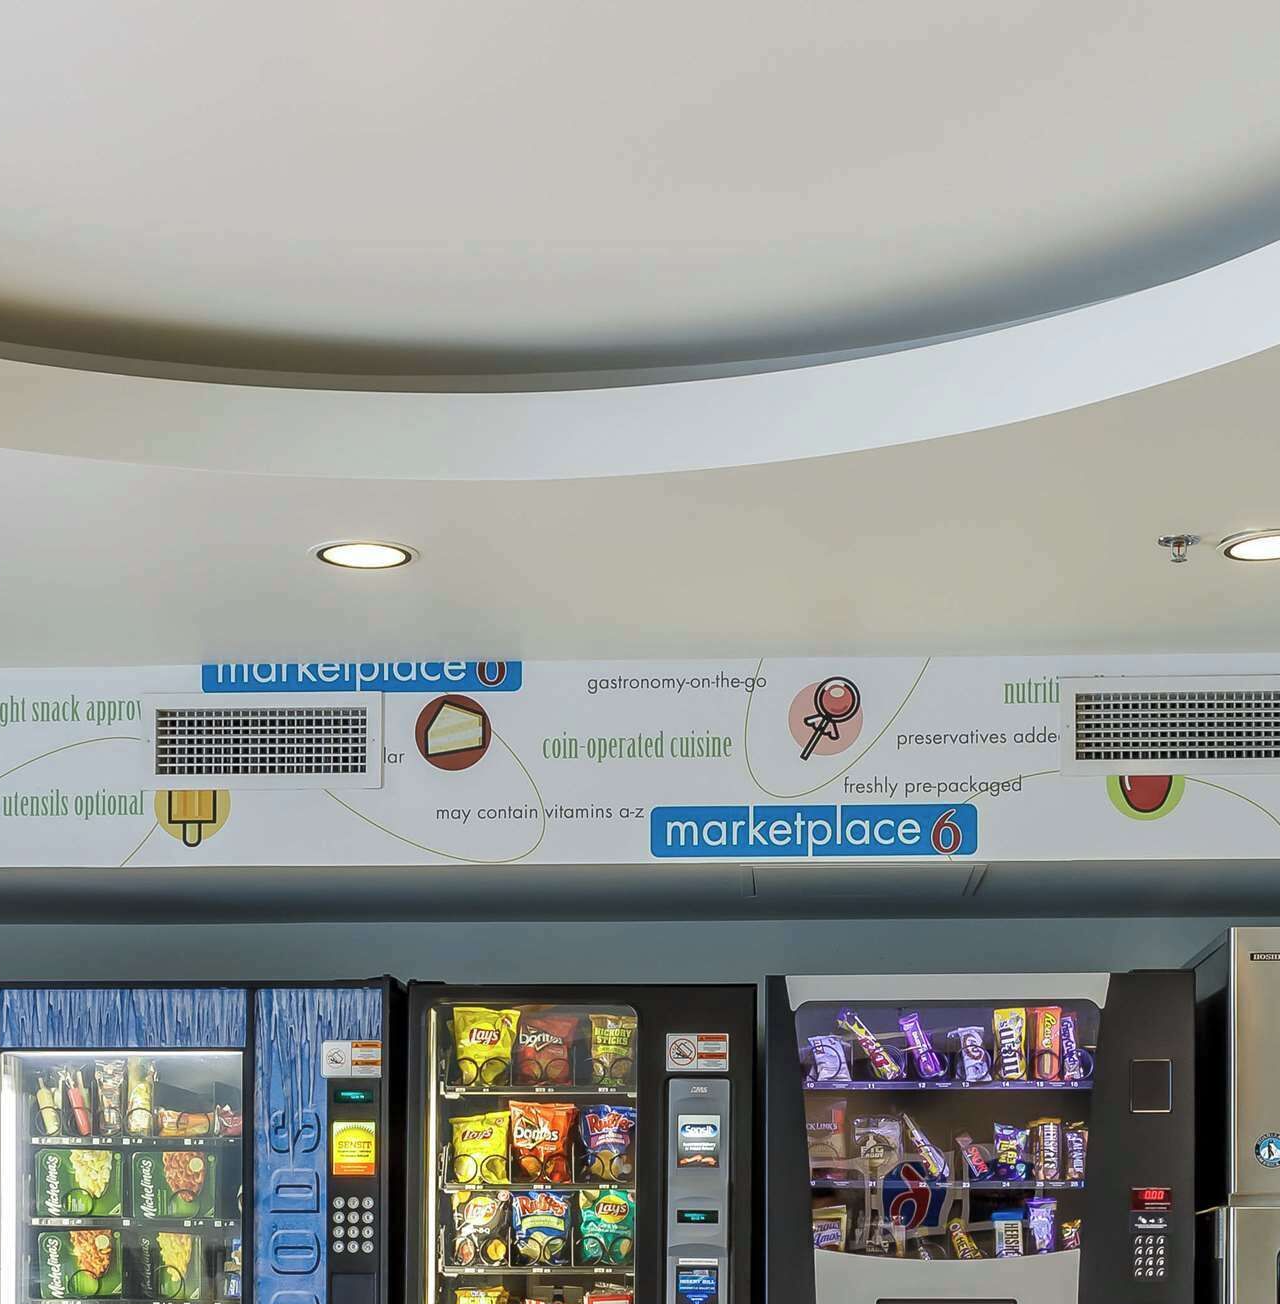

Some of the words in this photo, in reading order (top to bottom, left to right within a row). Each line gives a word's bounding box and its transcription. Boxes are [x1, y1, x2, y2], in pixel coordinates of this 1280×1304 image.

[588, 674, 767, 694] gastronomy-on-the-go
[31, 695, 80, 721] snack
[542, 730, 665, 761] coin-operated
[670, 730, 733, 758] cuisine
[897, 728, 1007, 750] preservatives
[1013, 725, 1060, 743] adde
[843, 776, 895, 799] freshly
[904, 776, 1023, 799] pre-packaged
[3, 791, 69, 817] utensils
[74, 789, 144, 820] optional
[436, 808, 472, 822] may
[477, 803, 538, 820] contain
[545, 802, 613, 820] vitamins
[619, 807, 645, 819] a-z
[666, 804, 921, 857] marketplace
[931, 808, 962, 855] 6
[596, 1036, 628, 1046] STICKS
